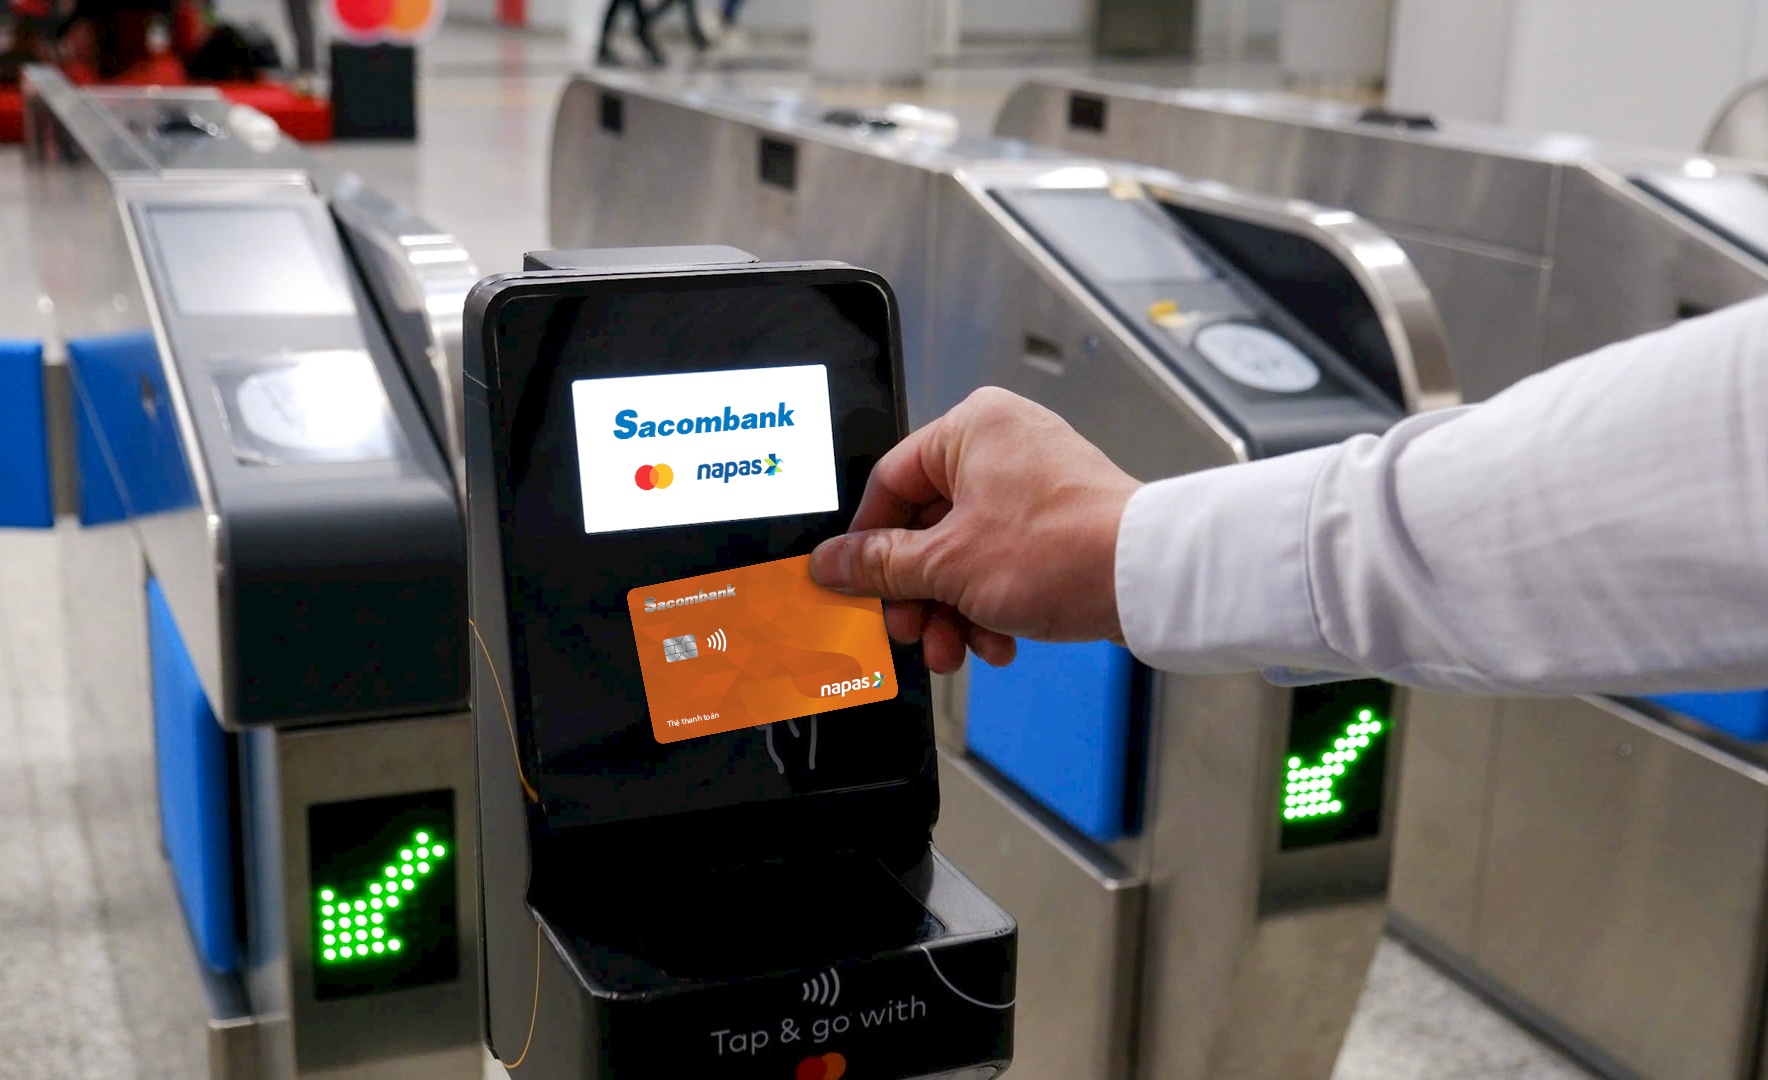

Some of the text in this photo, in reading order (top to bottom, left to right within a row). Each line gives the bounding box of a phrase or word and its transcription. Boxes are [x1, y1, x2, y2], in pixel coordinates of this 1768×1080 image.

[613, 402, 795, 440] Sacombank
[697, 459, 762, 483] napas
[644, 584, 737, 612] Sacombank
[821, 677, 870, 697] napas
[681, 714, 703, 725] thanh
[703, 712, 720, 721] toán
[711, 995, 926, 1056] Tap & go with
